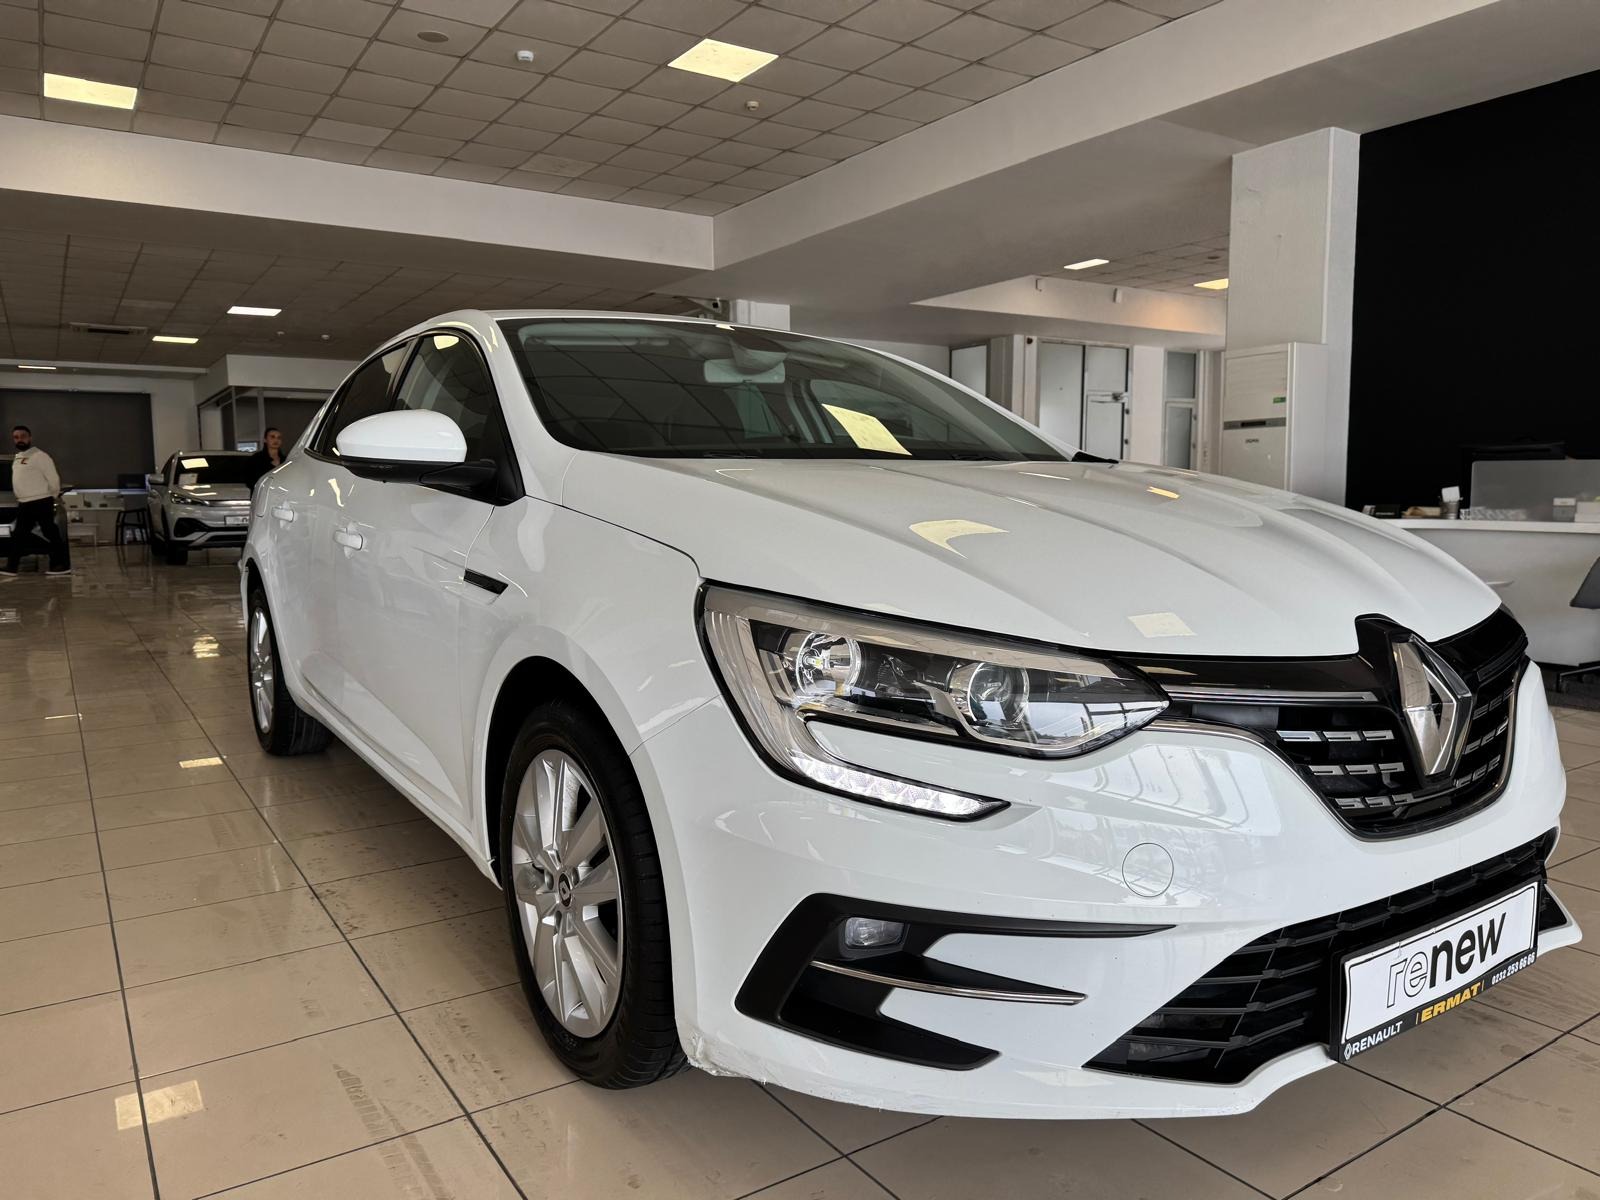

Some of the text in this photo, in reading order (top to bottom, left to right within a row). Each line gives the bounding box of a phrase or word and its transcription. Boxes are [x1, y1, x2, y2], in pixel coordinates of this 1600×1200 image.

[1387, 912, 1507, 1008] renew
[1351, 1020, 1403, 1055] RENAULT
[1420, 981, 1482, 1023] ERMAT
[1491, 969, 1507, 985] 0232
[1506, 961, 1519, 977] 253
